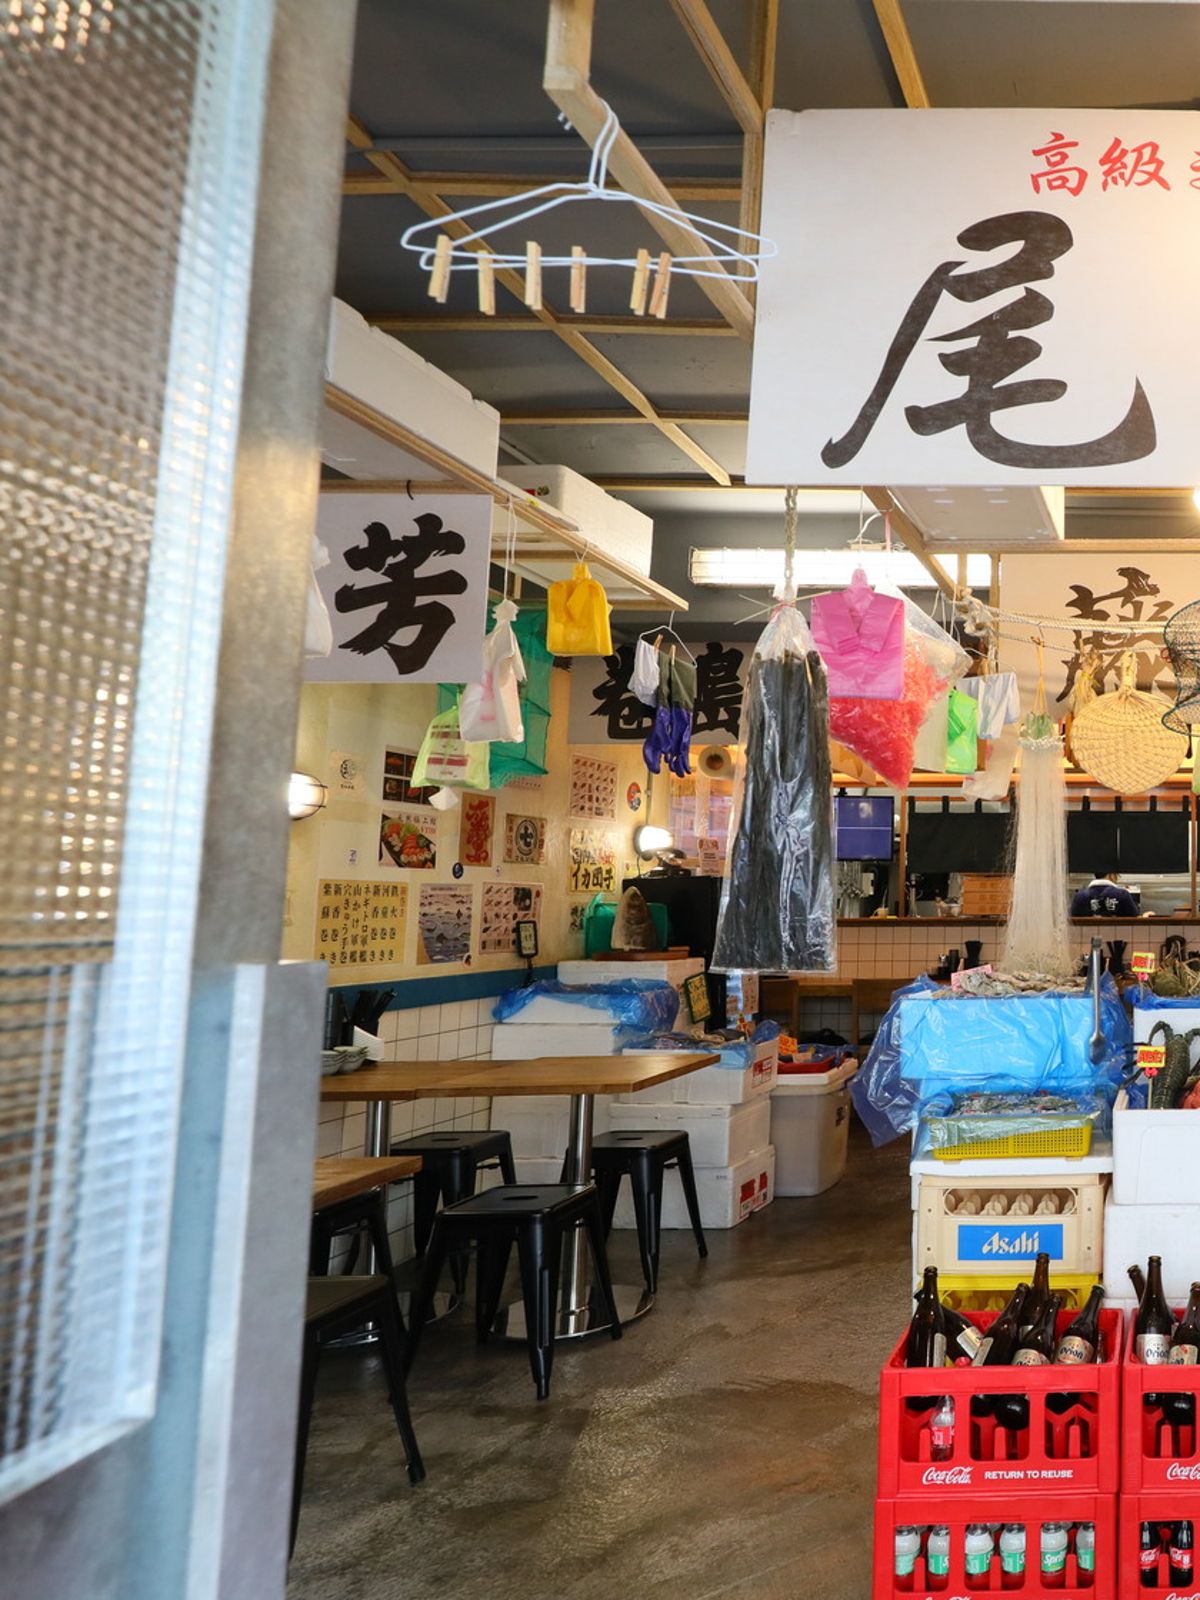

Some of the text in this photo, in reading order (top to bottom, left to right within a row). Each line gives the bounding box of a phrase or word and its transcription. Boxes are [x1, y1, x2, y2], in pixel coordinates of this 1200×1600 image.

[334, 511, 469, 676] 芳
[982, 1231, 1040, 1255] Asahi
[922, 1466, 974, 1486] Coca-Cola
[984, 1469, 1074, 1480] RETURN TO REUSE
